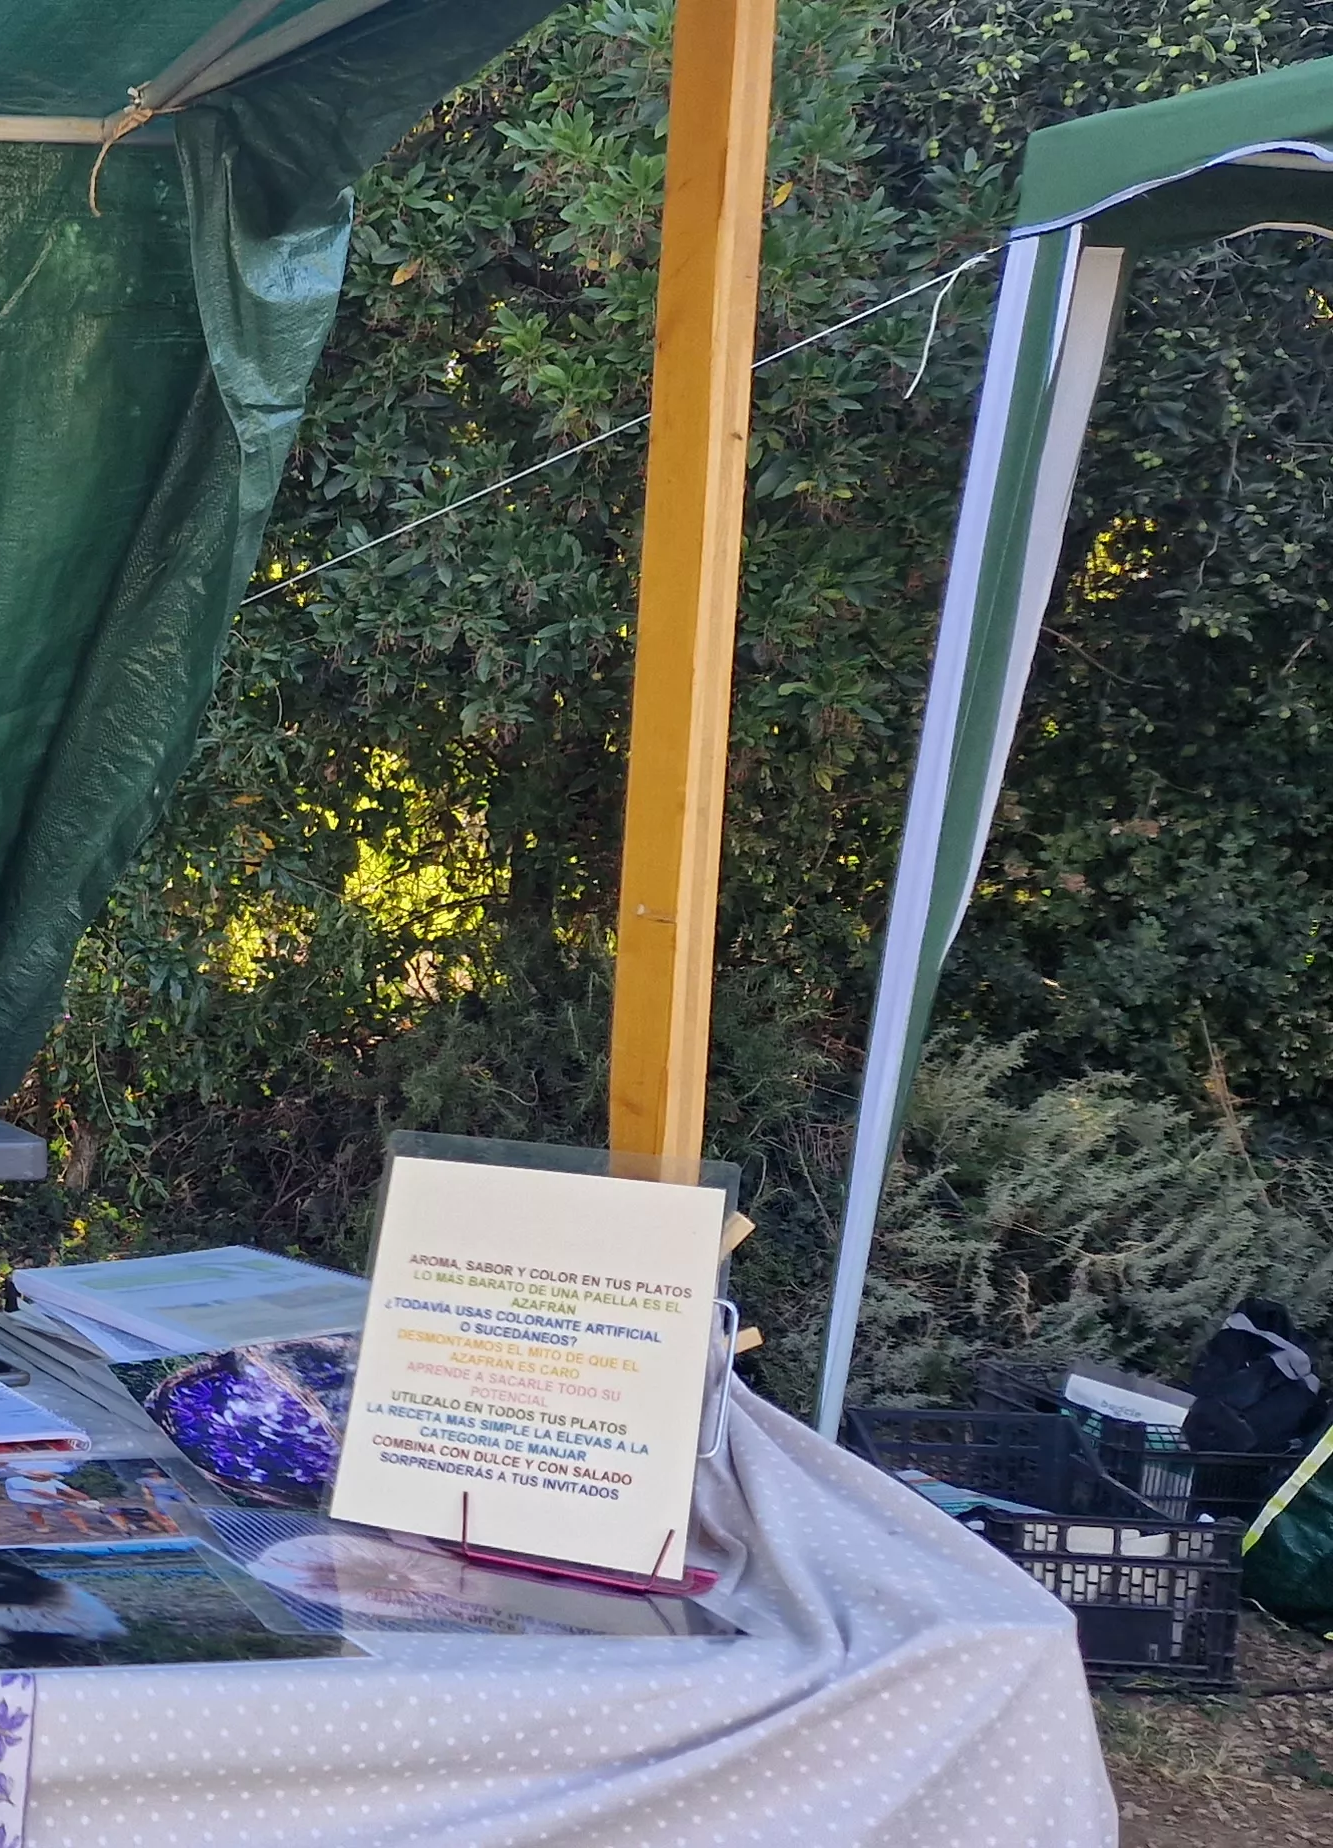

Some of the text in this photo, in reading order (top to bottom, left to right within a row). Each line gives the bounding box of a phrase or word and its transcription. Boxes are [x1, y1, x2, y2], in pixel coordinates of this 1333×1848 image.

[409, 1254, 693, 1299] AROMA, SABOR Y COLOR EN TUS PLATOS
[413, 1269, 432, 1281] LO
[468, 1276, 525, 1293] BARATO
[528, 1284, 547, 1296] DE
[551, 1287, 580, 1300] UNA
[584, 1290, 639, 1308] PAELLA
[642, 1298, 661, 1311] ES
[665, 1301, 683, 1314] EL
[384, 1296, 663, 1343] ¿TODAVÍA USAS COLORANTE ARTIFICIAL
[511, 1297, 577, 1316] AZAFRÁN
[397, 1328, 640, 1373] DESMONTAMOS EL MITO DE QUE EL
[460, 1321, 578, 1347] O SUCEDÁNEOS?
[406, 1361, 621, 1402] APRENDE A SACARLE TODO SU
[518, 1361, 535, 1374] ES
[540, 1364, 580, 1380] CARO
[464, 1401, 483, 1414] EN
[487, 1404, 535, 1421] TODOS
[539, 1412, 567, 1426] TUS
[570, 1416, 627, 1436] PLATOS
[470, 1386, 548, 1408] POTENCIAL
[366, 1402, 384, 1414] LA
[387, 1405, 442, 1423] RECETA
[479, 1419, 530, 1437] SIMPLE
[534, 1428, 552, 1441] LA
[556, 1430, 612, 1450] ELEVAS
[616, 1440, 627, 1453] A
[630, 1443, 649, 1455] LA
[419, 1426, 587, 1462] CATEGORIA DE MANJAR
[372, 1434, 633, 1486] COMBINA CON DULCE Y CON SALADO
[379, 1451, 620, 1501] SORPRENDERÁS A TUS INVITADOS
